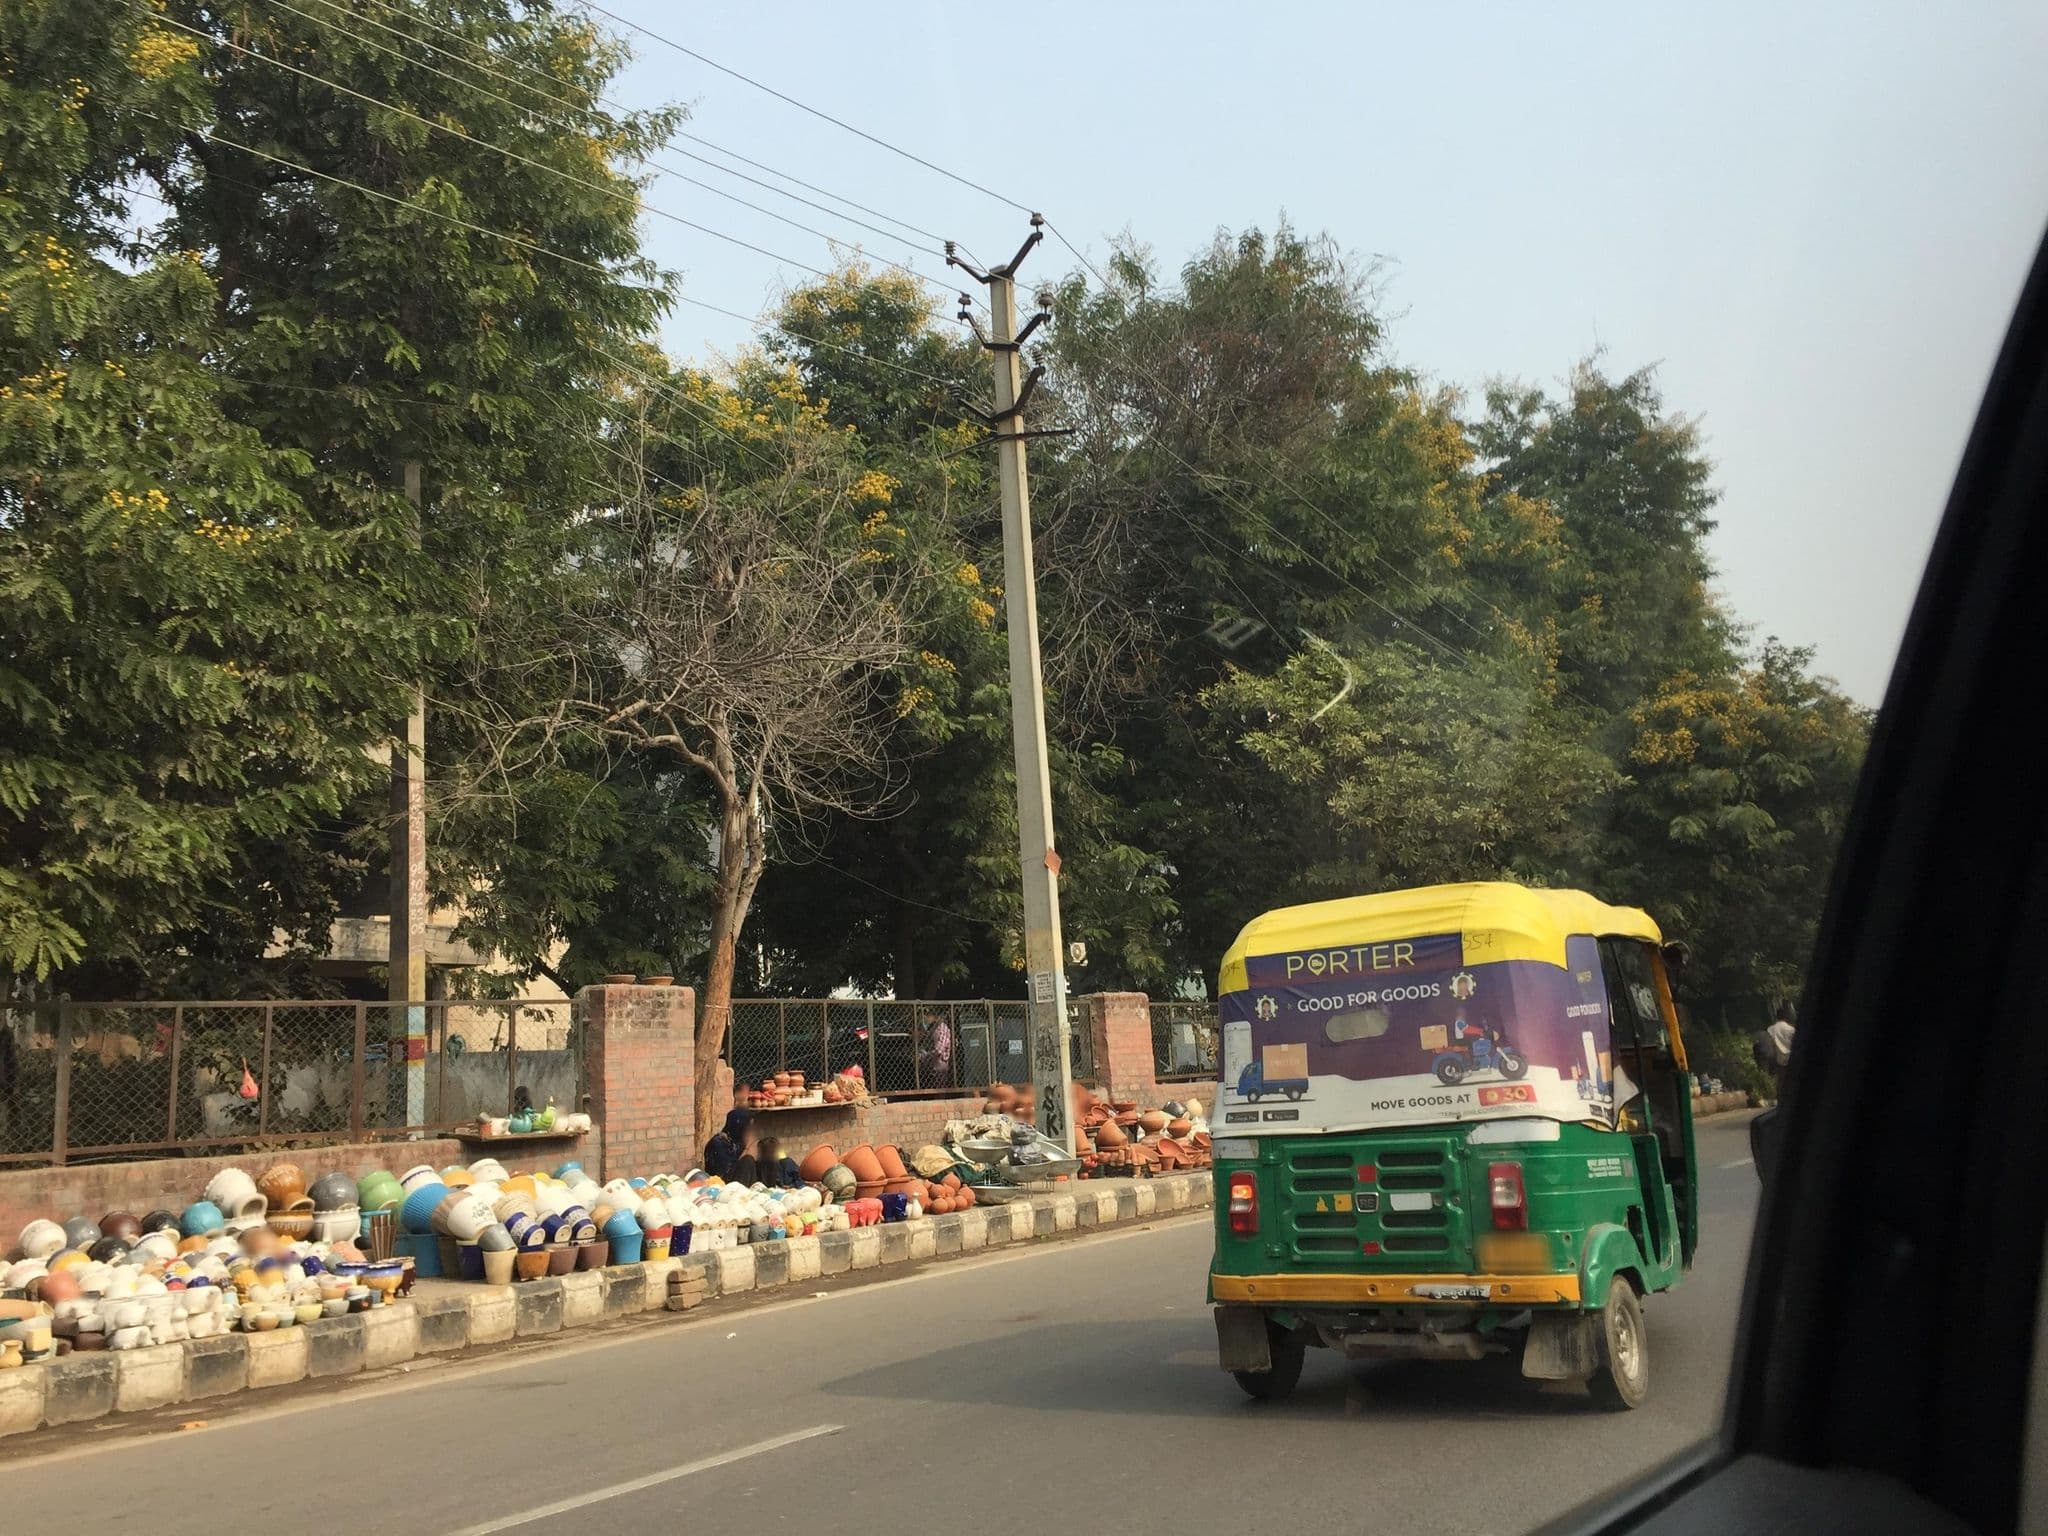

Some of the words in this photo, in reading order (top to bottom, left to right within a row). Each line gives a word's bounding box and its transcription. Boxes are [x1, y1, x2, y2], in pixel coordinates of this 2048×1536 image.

[1286, 943, 1415, 979] PORTER
[1298, 996, 1343, 1013] GOOD
[1347, 990, 1378, 1007] FOR
[1381, 983, 1441, 1001] GOODS
[1371, 1098, 1405, 1111] MOVE
[1408, 1095, 1453, 1107] GOODS
[1456, 1093, 1471, 1103] AT
